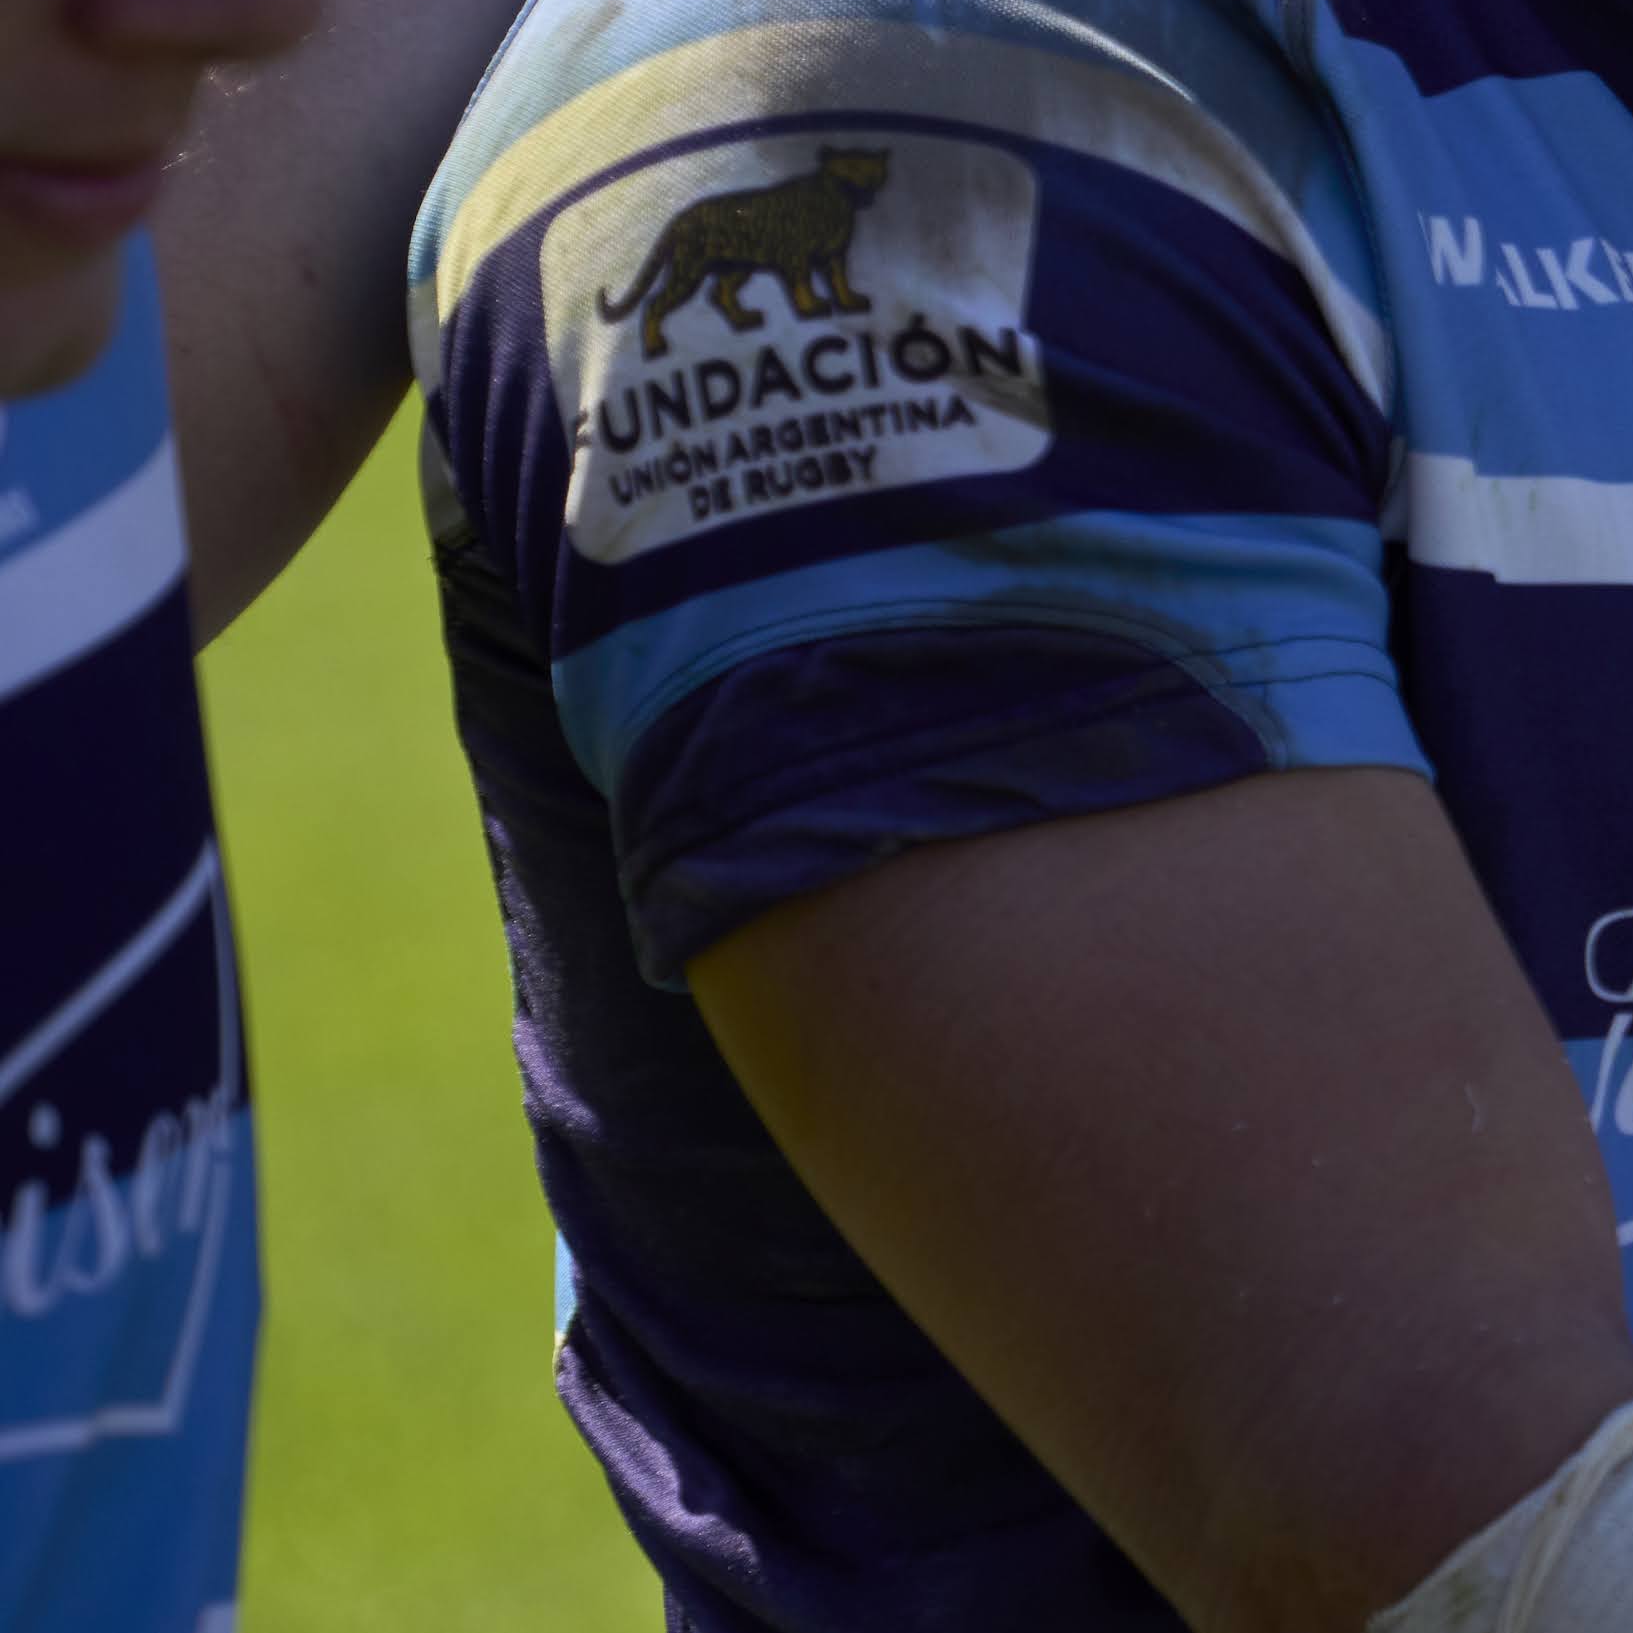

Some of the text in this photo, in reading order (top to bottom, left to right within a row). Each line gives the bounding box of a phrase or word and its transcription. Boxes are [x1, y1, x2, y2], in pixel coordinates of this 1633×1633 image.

[575, 313, 1024, 453] UNDACIÓN
[610, 395, 976, 506] UNIÓN ARGENTINA
[689, 446, 879, 522] DE RUGBY
